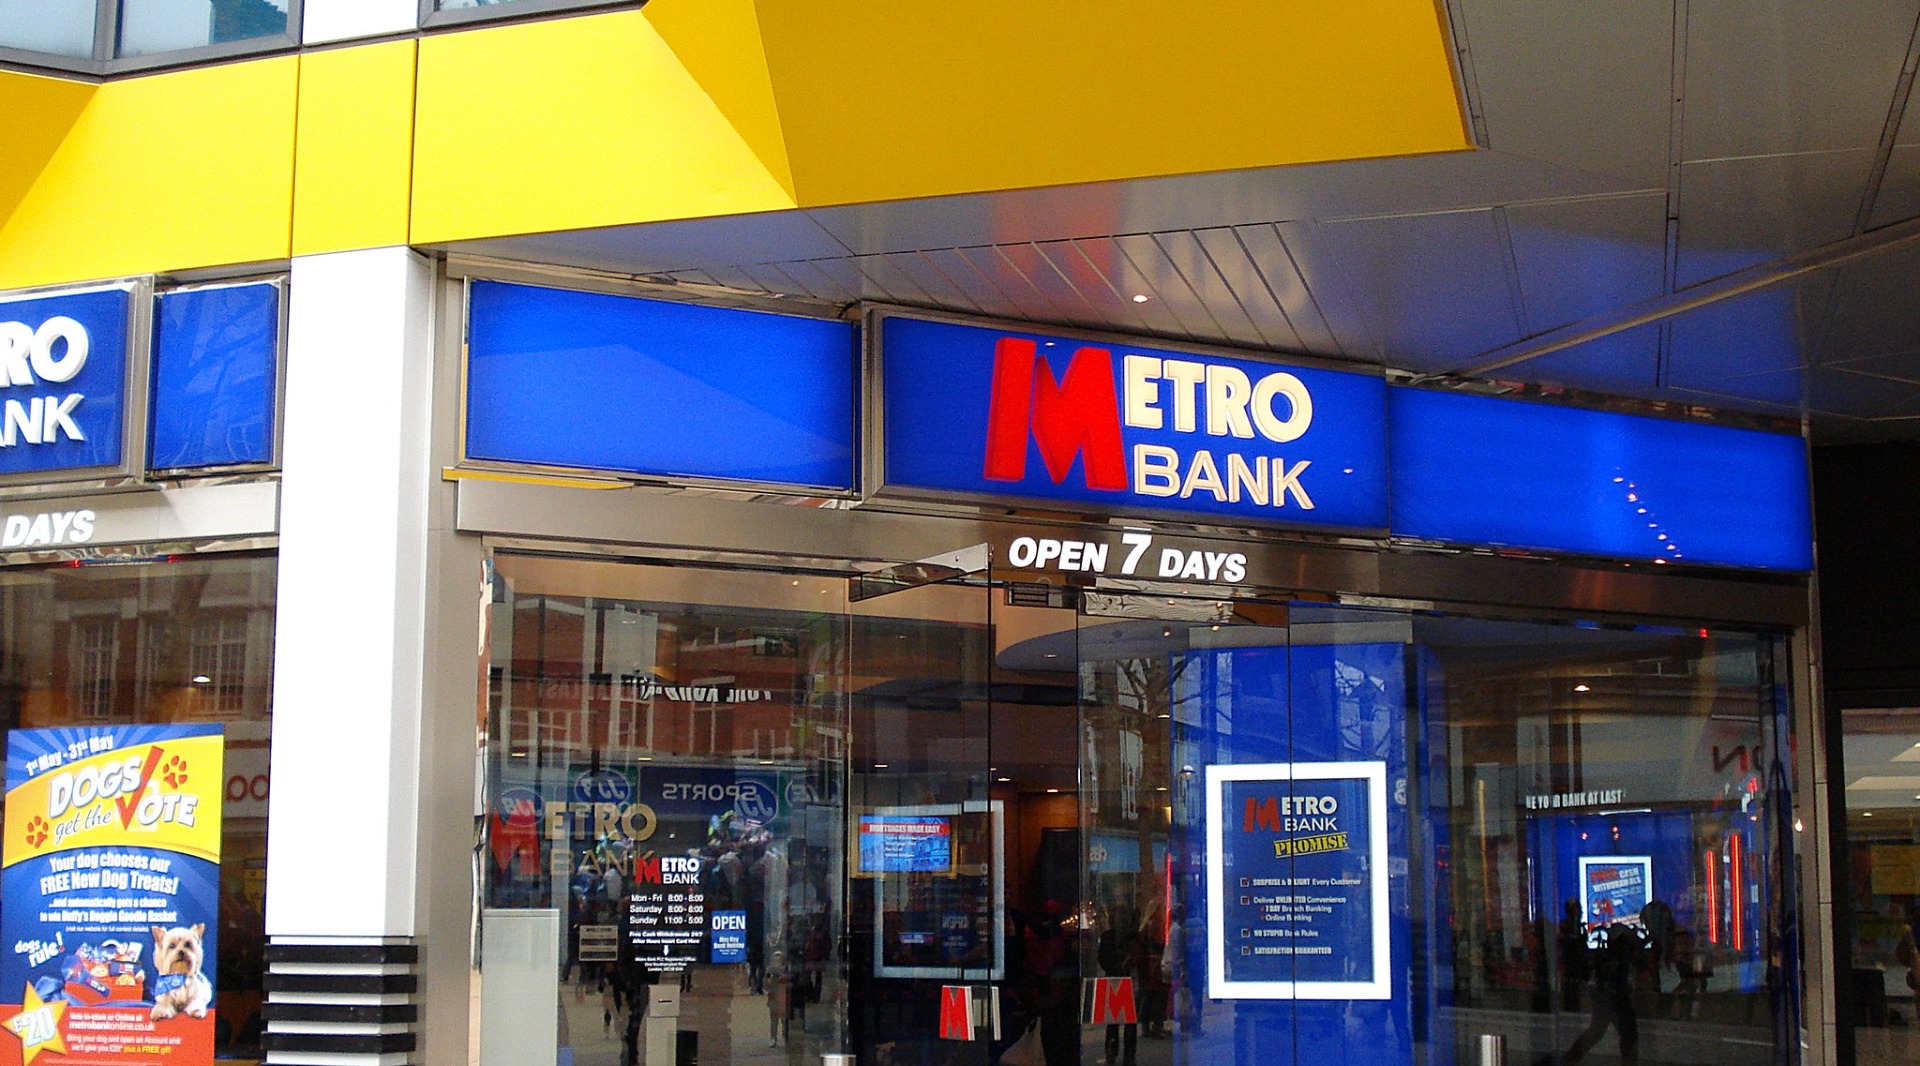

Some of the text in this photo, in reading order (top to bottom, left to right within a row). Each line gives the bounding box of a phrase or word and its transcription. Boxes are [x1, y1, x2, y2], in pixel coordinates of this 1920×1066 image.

[0, 393, 85, 447] NK
[983, 337, 1313, 491] METRO
[1133, 443, 1316, 510] BANK
[2, 509, 95, 547] DAYS
[1008, 531, 1246, 583] OPEN 7 DAYS
[25, 760, 38, 776] 1st
[38, 750, 62, 771] May
[68, 741, 88, 759] 31st
[89, 735, 114, 751] May
[49, 757, 142, 819] DOGS
[1562, 792, 1586, 807] BANK
[1587, 791, 1598, 806] AT
[1600, 790, 1622, 804] LAST
[55, 817, 79, 844] get
[84, 804, 111, 829] the
[1243, 796, 1337, 832] METRO
[1285, 818, 1338, 831] BANK
[1275, 834, 1348, 856] PROMISE
[50, 852, 171, 873] Your dog chooses our
[635, 857, 700, 884] METRO
[40, 870, 178, 895] FREE New Dog Treats!
[663, 874, 700, 884] BANK
[1312, 879, 1329, 887] Every
[1330, 878, 1361, 886] Customer
[629, 905, 662, 914] Saturday
[668, 905, 683, 913] 8:00
[631, 894, 647, 902] Mon
[652, 894, 662, 902] Fri
[668, 894, 683, 902] 8:00
[688, 894, 704, 902] 8:00
[1305, 905, 1332, 913] Banking
[1307, 896, 1346, 904] Convenience
[629, 916, 658, 925] Sunday
[664, 916, 682, 924] 11:00
[688, 916, 704, 924] 5:00
[712, 915, 746, 930] OPEN
[15, 939, 40, 954] dogs
[28, 931, 65, 968] rule!
[1093, 977, 1138, 1024] M
[12, 1006, 56, 1048] £20
[69, 1021, 155, 1031] metrobankonline.co.uk
